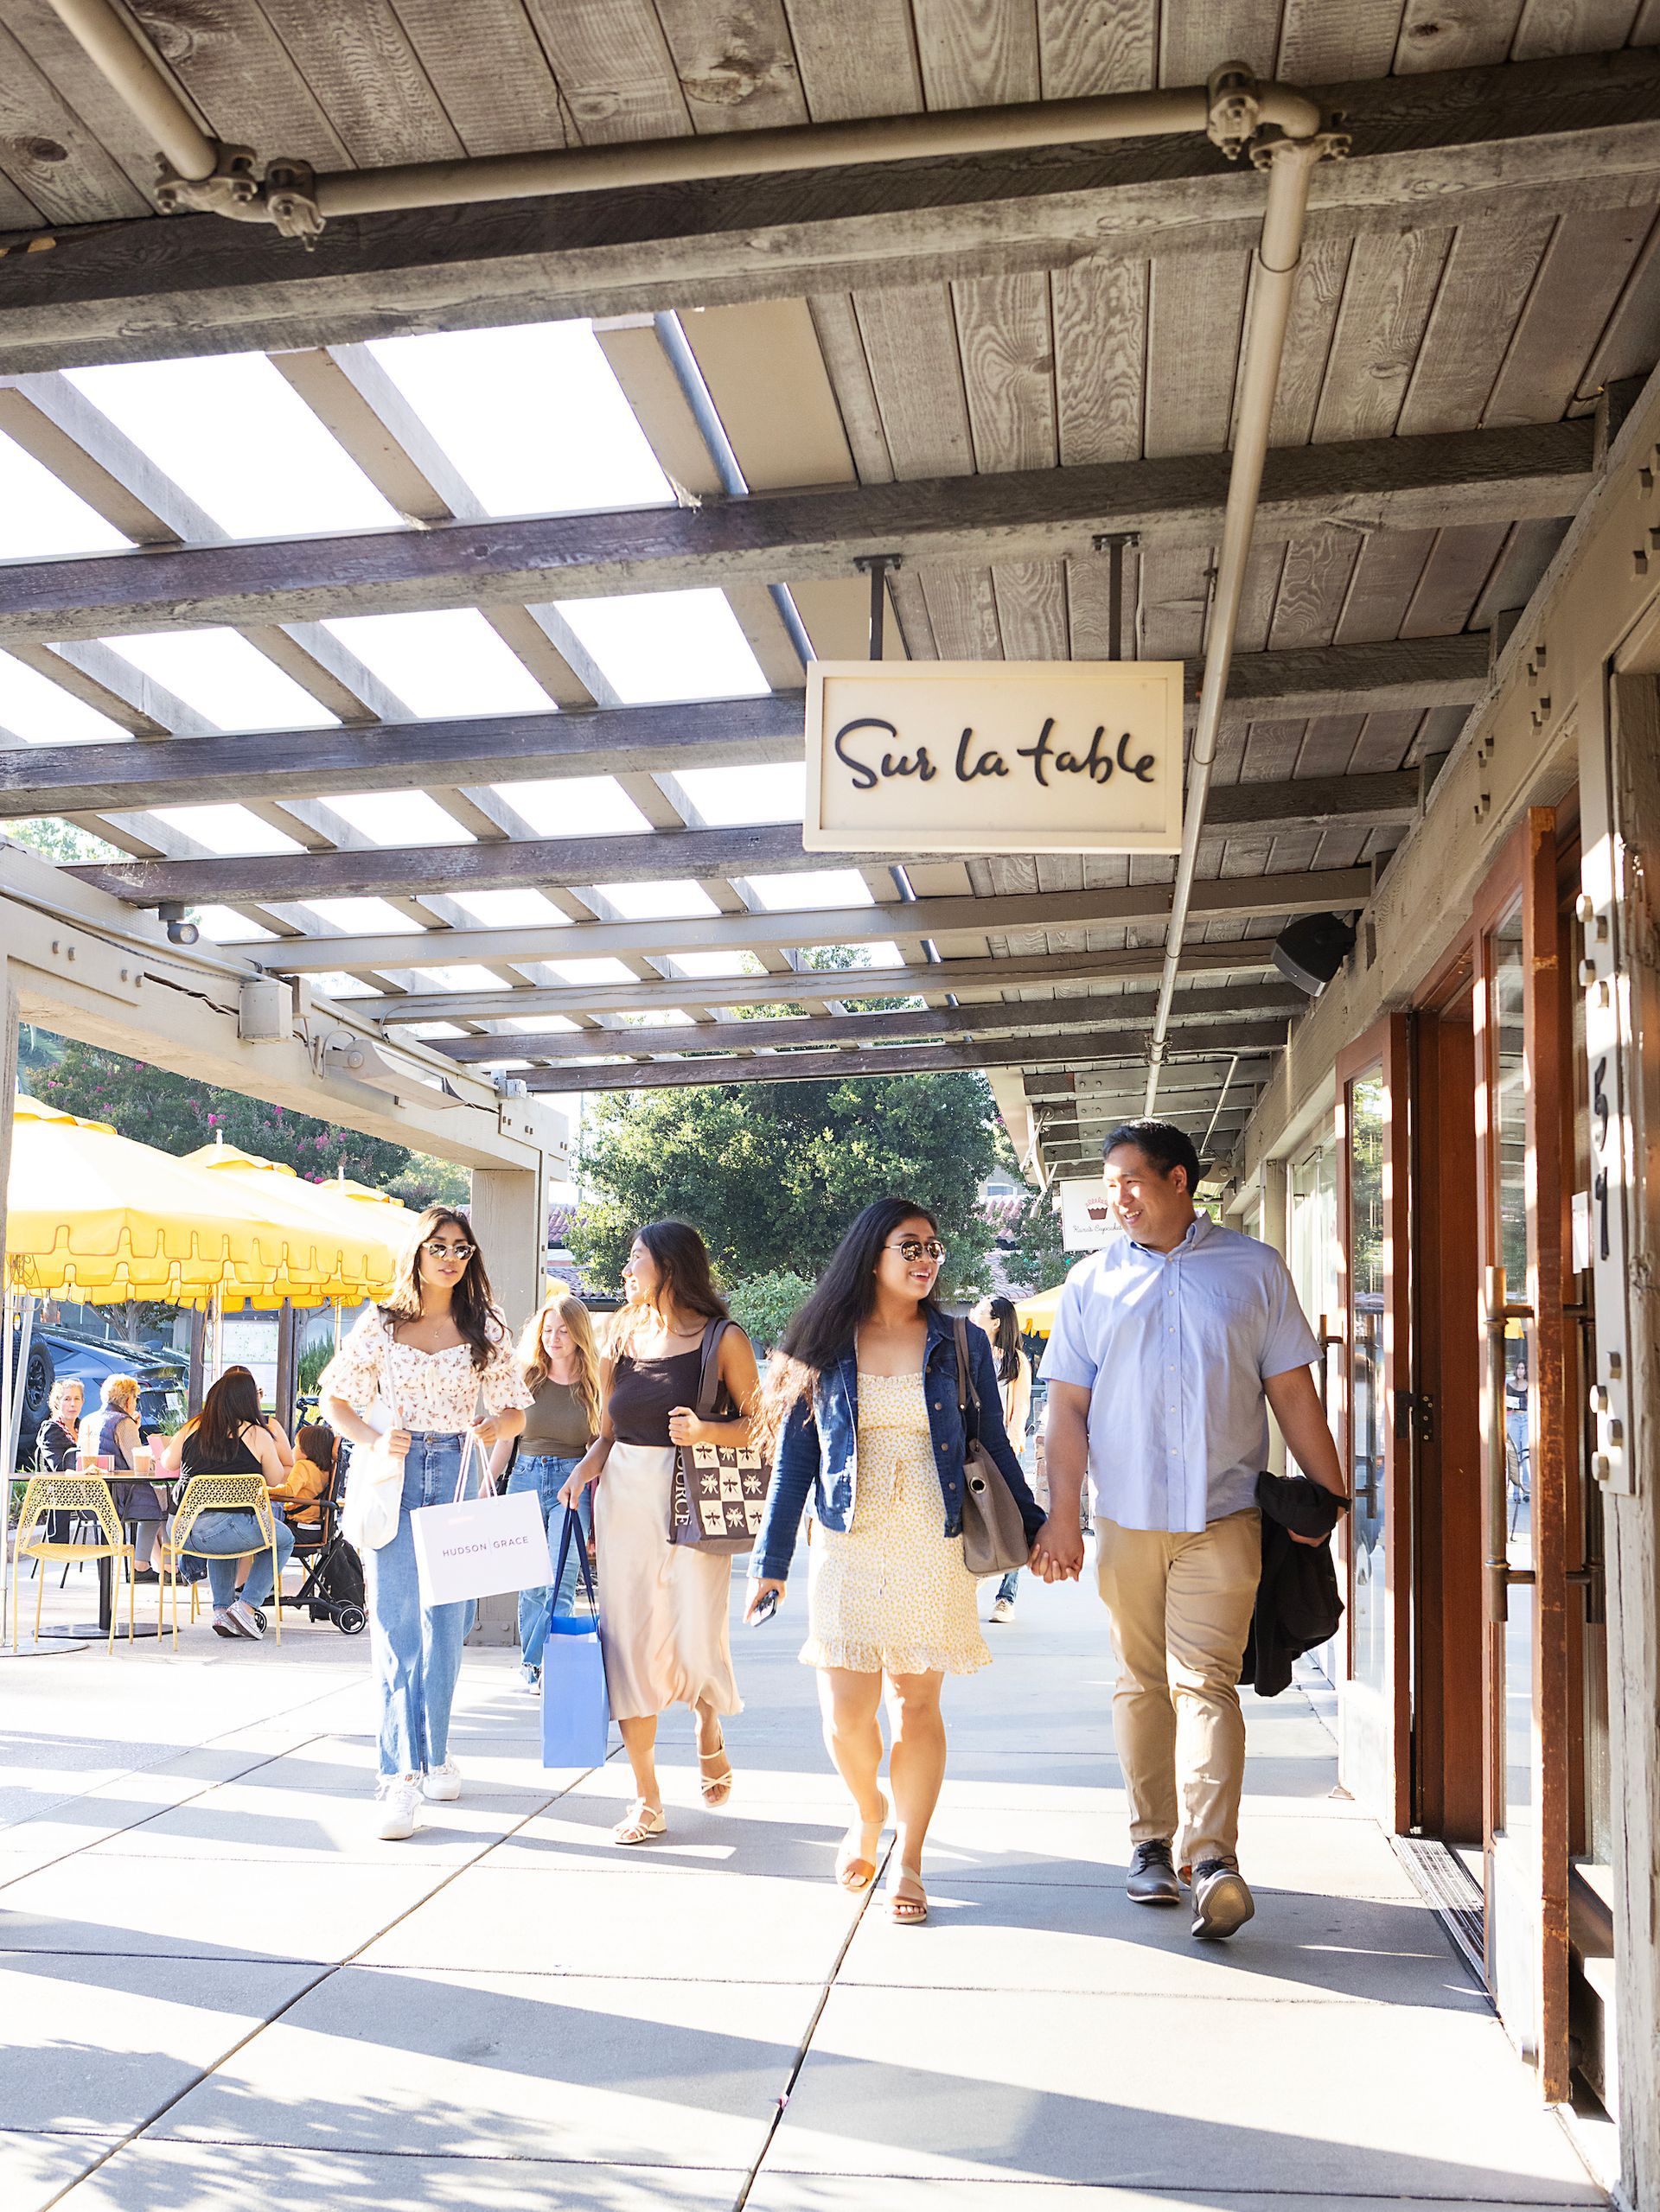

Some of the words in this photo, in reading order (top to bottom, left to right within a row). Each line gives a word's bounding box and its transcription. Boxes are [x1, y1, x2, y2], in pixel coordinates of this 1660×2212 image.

[834, 717, 936, 789] Sur
[1017, 717, 1155, 787] table
[443, 1543, 488, 1557] HUDSON
[493, 1536, 529, 1549] GRACE
